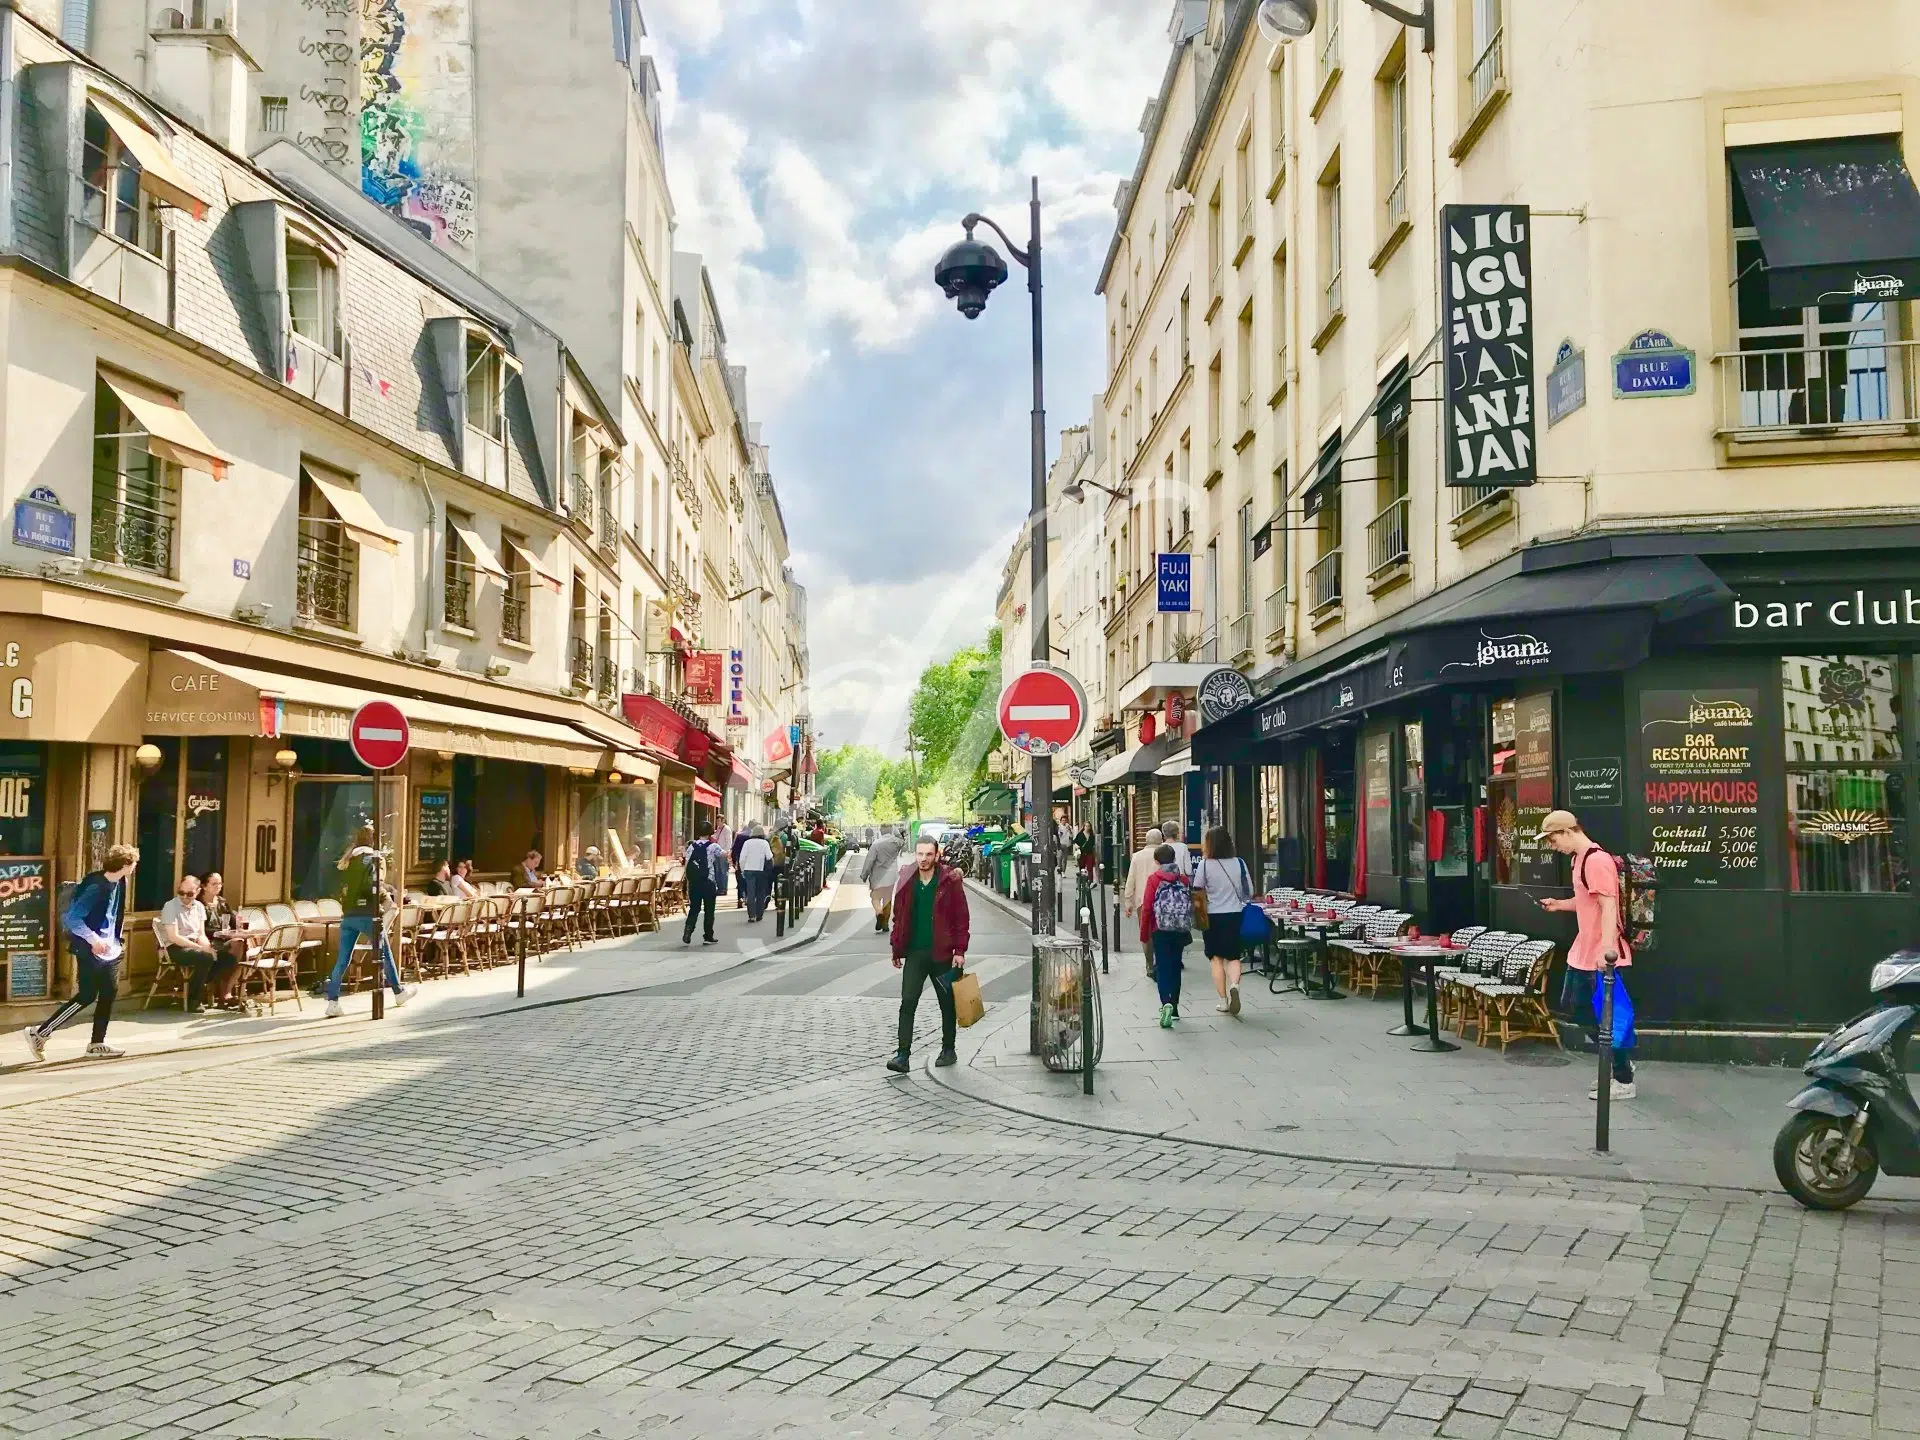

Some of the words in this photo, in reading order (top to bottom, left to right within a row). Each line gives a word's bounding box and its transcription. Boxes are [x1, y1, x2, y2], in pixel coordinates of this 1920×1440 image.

[1878, 288, 1900, 297] café
[1639, 361, 1669, 373] RUE
[1632, 375, 1678, 388] DAVAL
[35, 511, 56, 524] RUE
[39, 523, 51, 533] DE
[17, 528, 29, 538] LA
[31, 531, 72, 549] ROQUETTE
[236, 560, 249, 577] 32
[1161, 562, 1188, 575] FUJI
[1161, 579, 1188, 592] YAKI
[1734, 600, 1813, 628] bar
[1827, 589, 1920, 626] club
[1515, 658, 1531, 666] café
[1531, 657, 1550, 666] paris
[171, 673, 220, 692] CAFE
[730, 649, 744, 716] HOTEL
[1205, 672, 1249, 695] BAGELSTEIN
[146, 711, 196, 723] SERVICE
[200, 711, 256, 723] CONTINU
[307, 708, 326, 736] LE
[1261, 712, 1272, 732] bar
[1272, 705, 1287, 727] club
[1728, 718, 1753, 727] bastille
[1685, 733, 1715, 747] BAR
[1652, 747, 1750, 761] RESTAURANT
[1569, 770, 1600, 778] OUVERT
[1645, 781, 1758, 804] HAPPYHOURS
[188, 795, 221, 813] Carlsberg
[1648, 805, 1664, 814] de
[1669, 805, 1683, 814] 17
[1687, 805, 1695, 814] à
[1699, 805, 1758, 814] 21heures
[1652, 825, 1708, 838] Cocktail
[1718, 826, 1757, 839] 5,50€
[1821, 822, 1870, 832] ORGASMIC
[1651, 840, 1712, 853] Mocktail
[1719, 841, 1758, 854] 5,00€
[1654, 855, 1689, 868] Pinte
[1719, 856, 1759, 869] 5,00€
